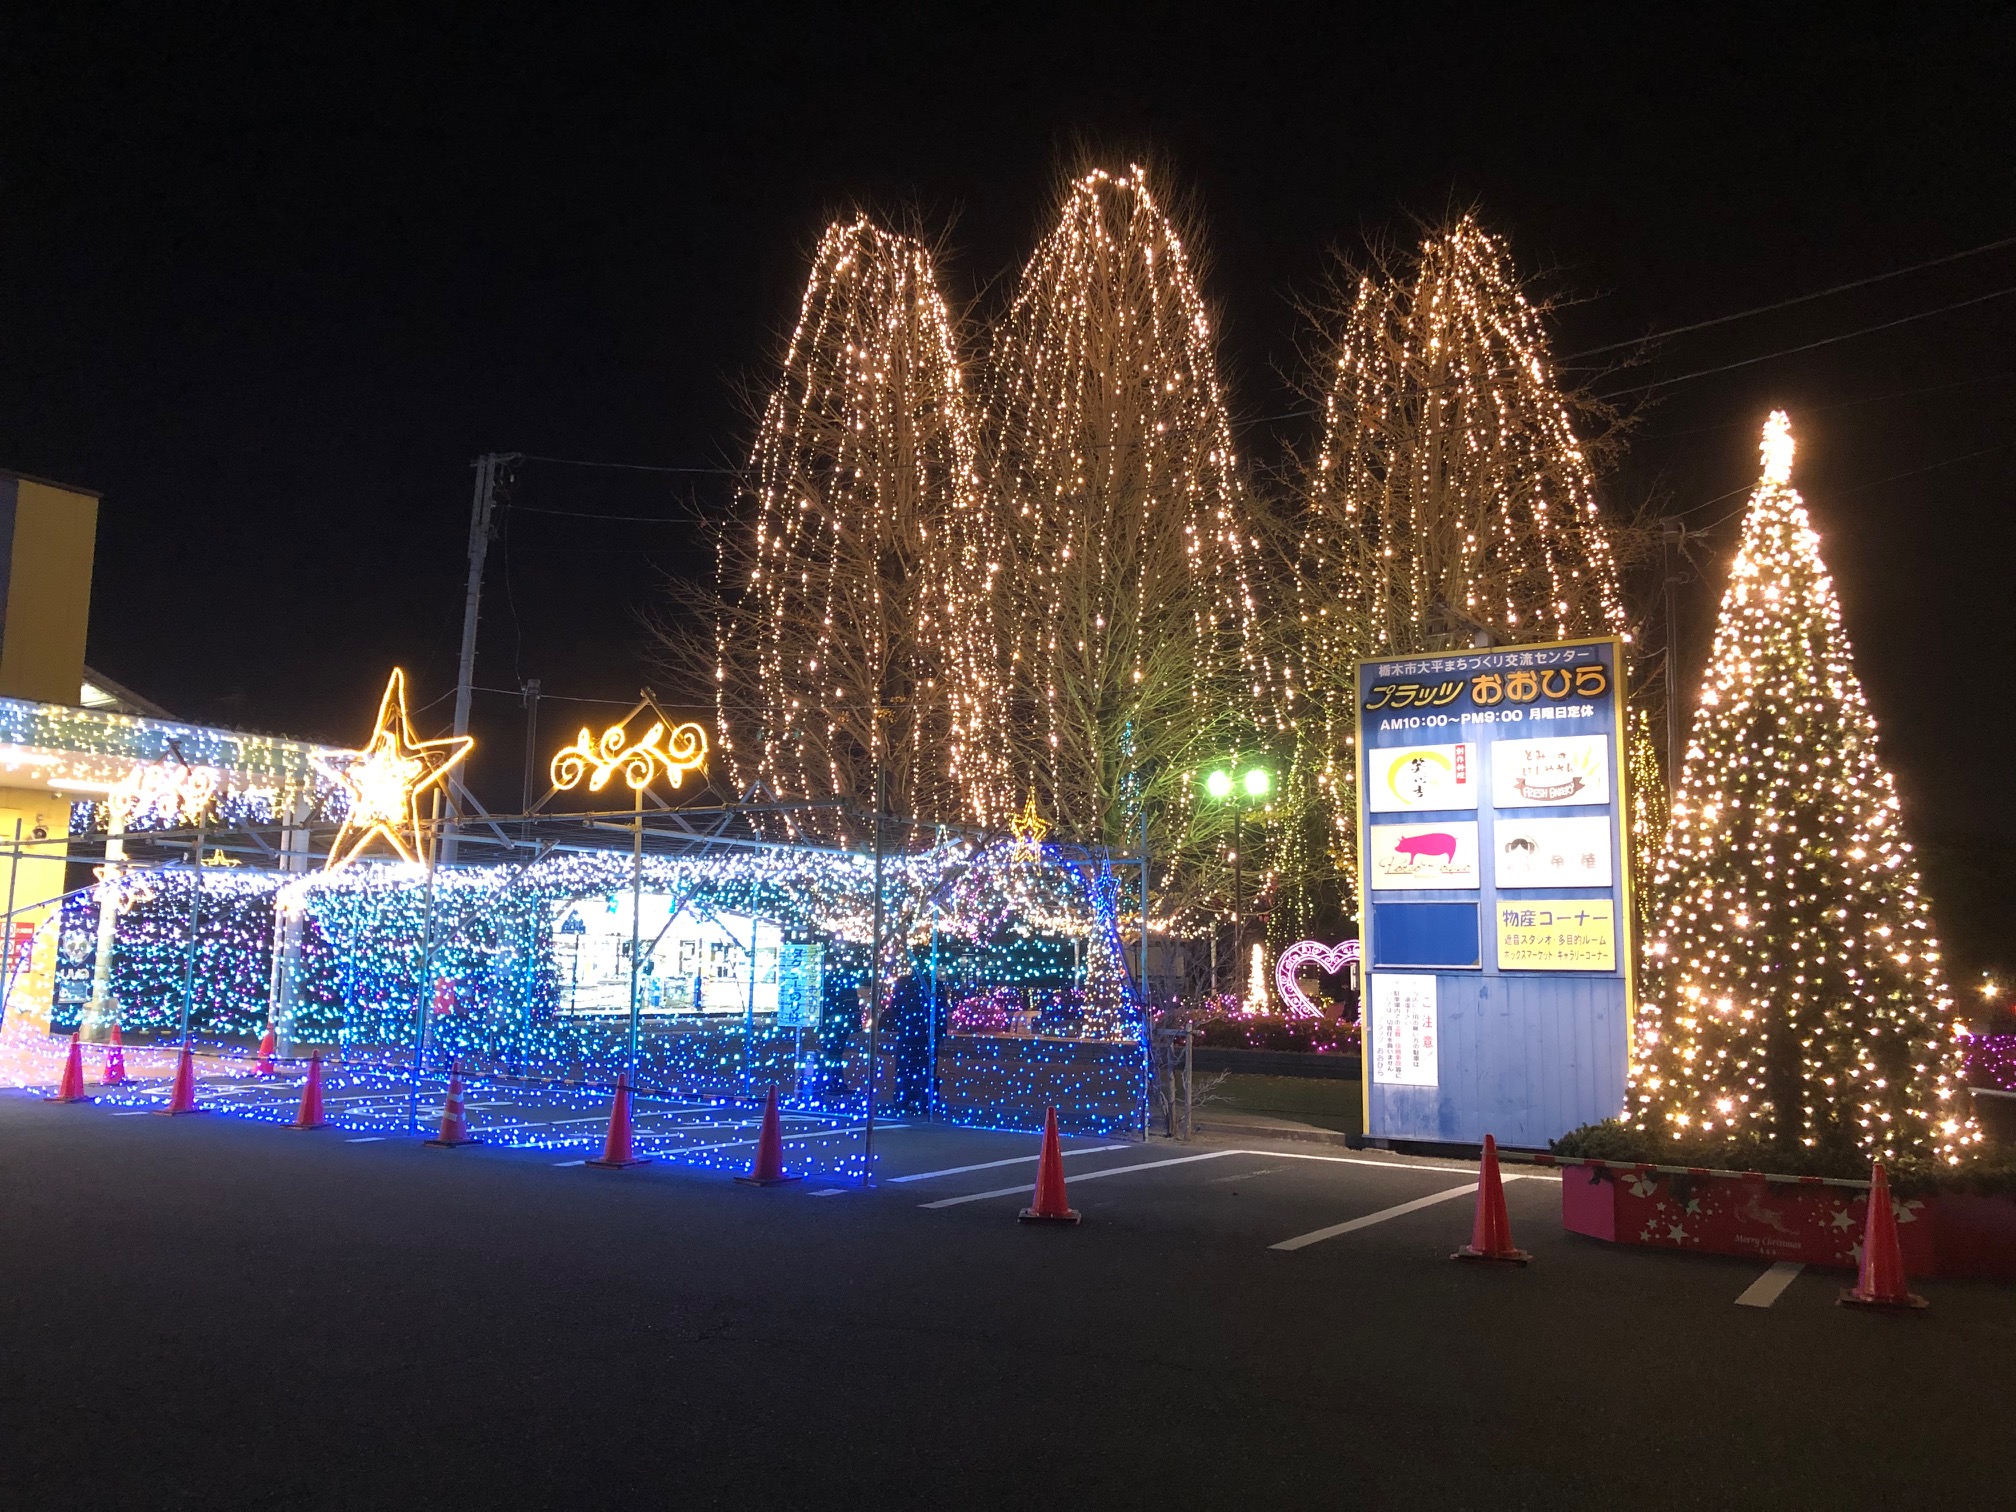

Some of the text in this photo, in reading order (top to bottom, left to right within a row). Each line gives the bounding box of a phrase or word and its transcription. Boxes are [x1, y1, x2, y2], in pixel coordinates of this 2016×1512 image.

[1378, 652, 1590, 677] 栃木市大平まちづくり交流センター
[1365, 665, 1607, 710] プラッツ おおひら
[1528, 705, 1595, 721] 月曜日定休
[1523, 782, 1575, 799] FRESH BAKERY
[1502, 909, 1609, 927] 物産コーナー
[1735, 1233, 1802, 1249] Merry Christmas
